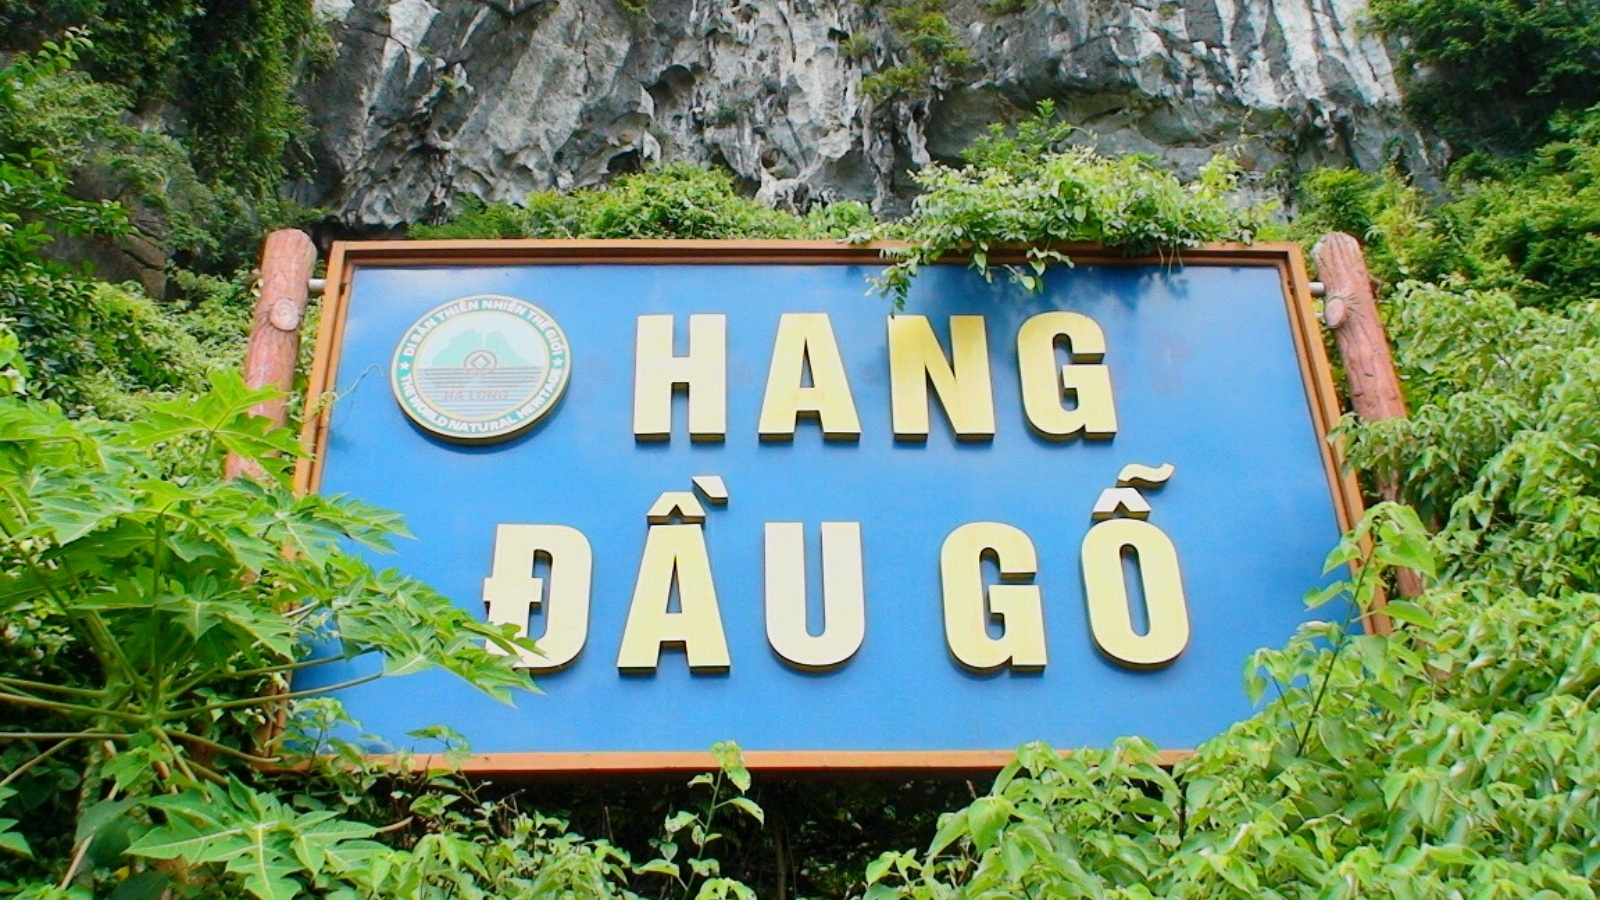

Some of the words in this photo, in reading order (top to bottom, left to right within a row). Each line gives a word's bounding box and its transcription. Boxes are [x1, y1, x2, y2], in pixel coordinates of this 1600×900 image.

[403, 341, 418, 356] DI
[633, 311, 1118, 442] HANG
[401, 374, 415, 397] THE
[408, 394, 448, 426] WORLD
[446, 414, 518, 433] NATURAL
[516, 368, 562, 419] HERITAGE
[468, 389, 509, 401] LONG
[483, 475, 866, 672] ĐẦU
[940, 463, 1191, 671] GỖ
